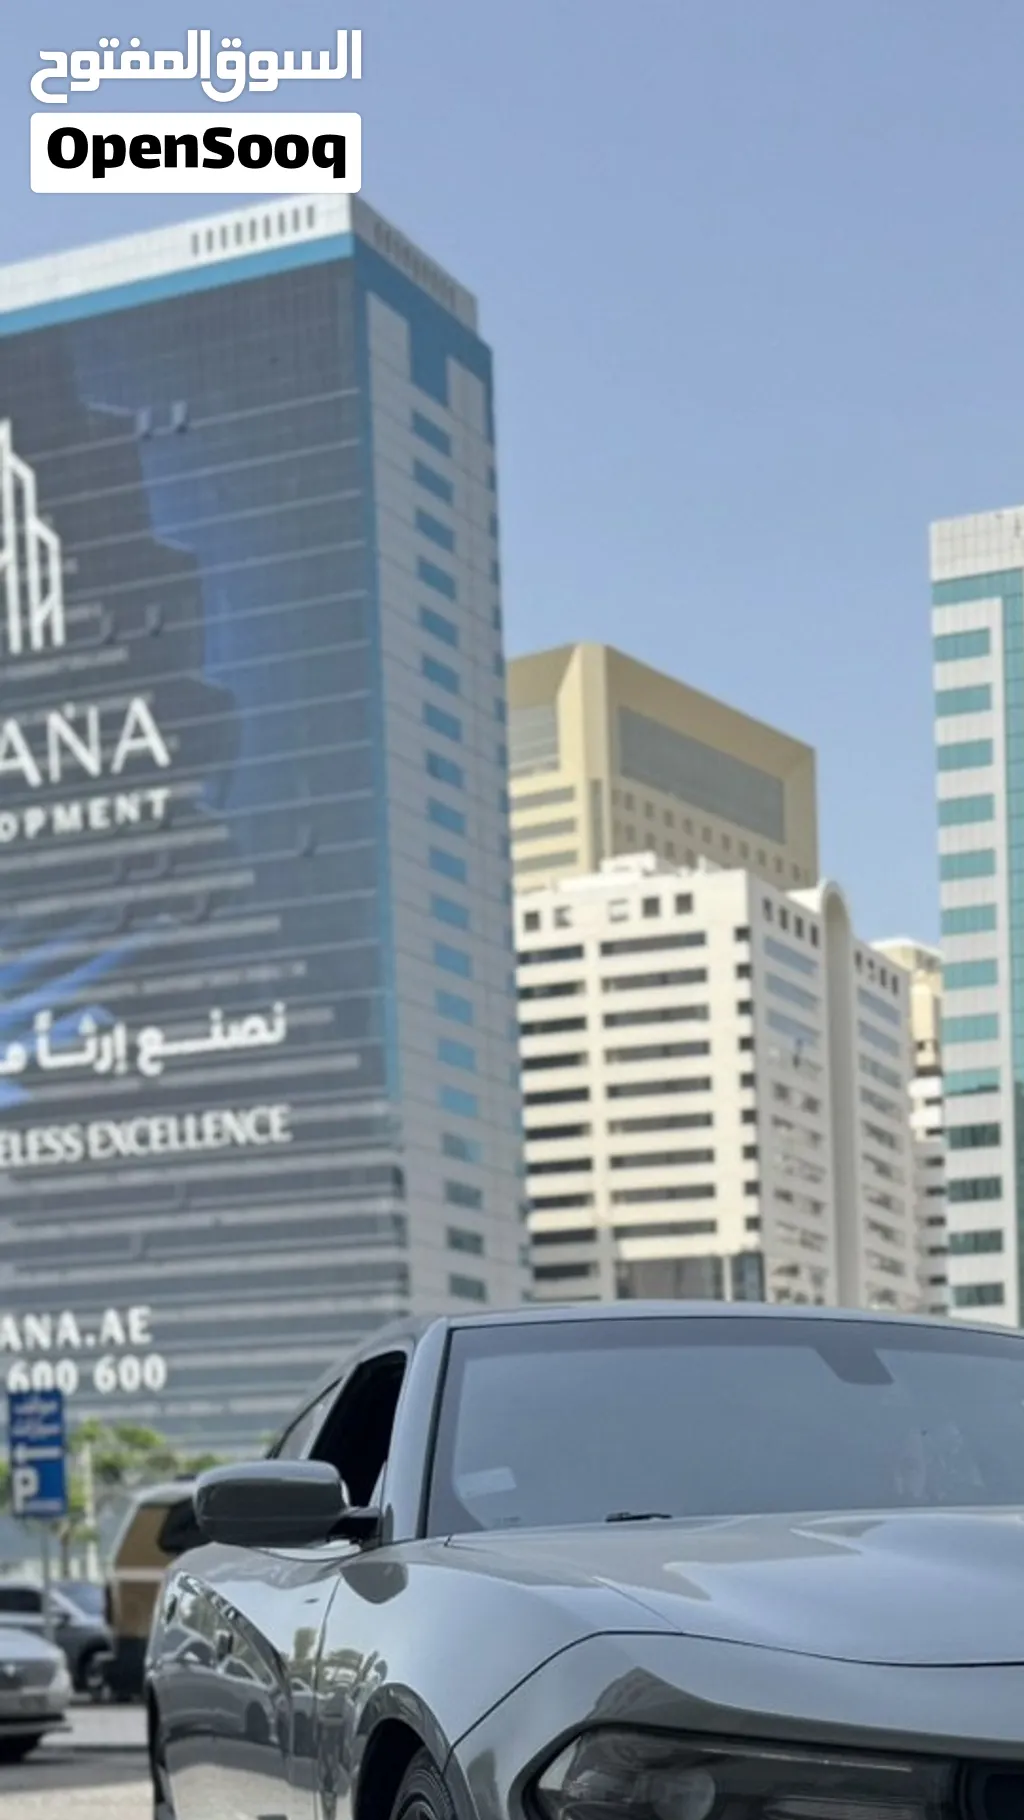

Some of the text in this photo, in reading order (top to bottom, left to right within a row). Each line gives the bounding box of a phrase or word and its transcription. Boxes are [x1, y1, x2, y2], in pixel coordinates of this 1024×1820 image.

[0, 788, 171, 843] OPMENT
[87, 1104, 293, 1160] EXCELLENCE
[0, 1304, 153, 1351] ANA.AE
[7, 1352, 167, 1396] 600 600
[13, 1466, 39, 1515] P
